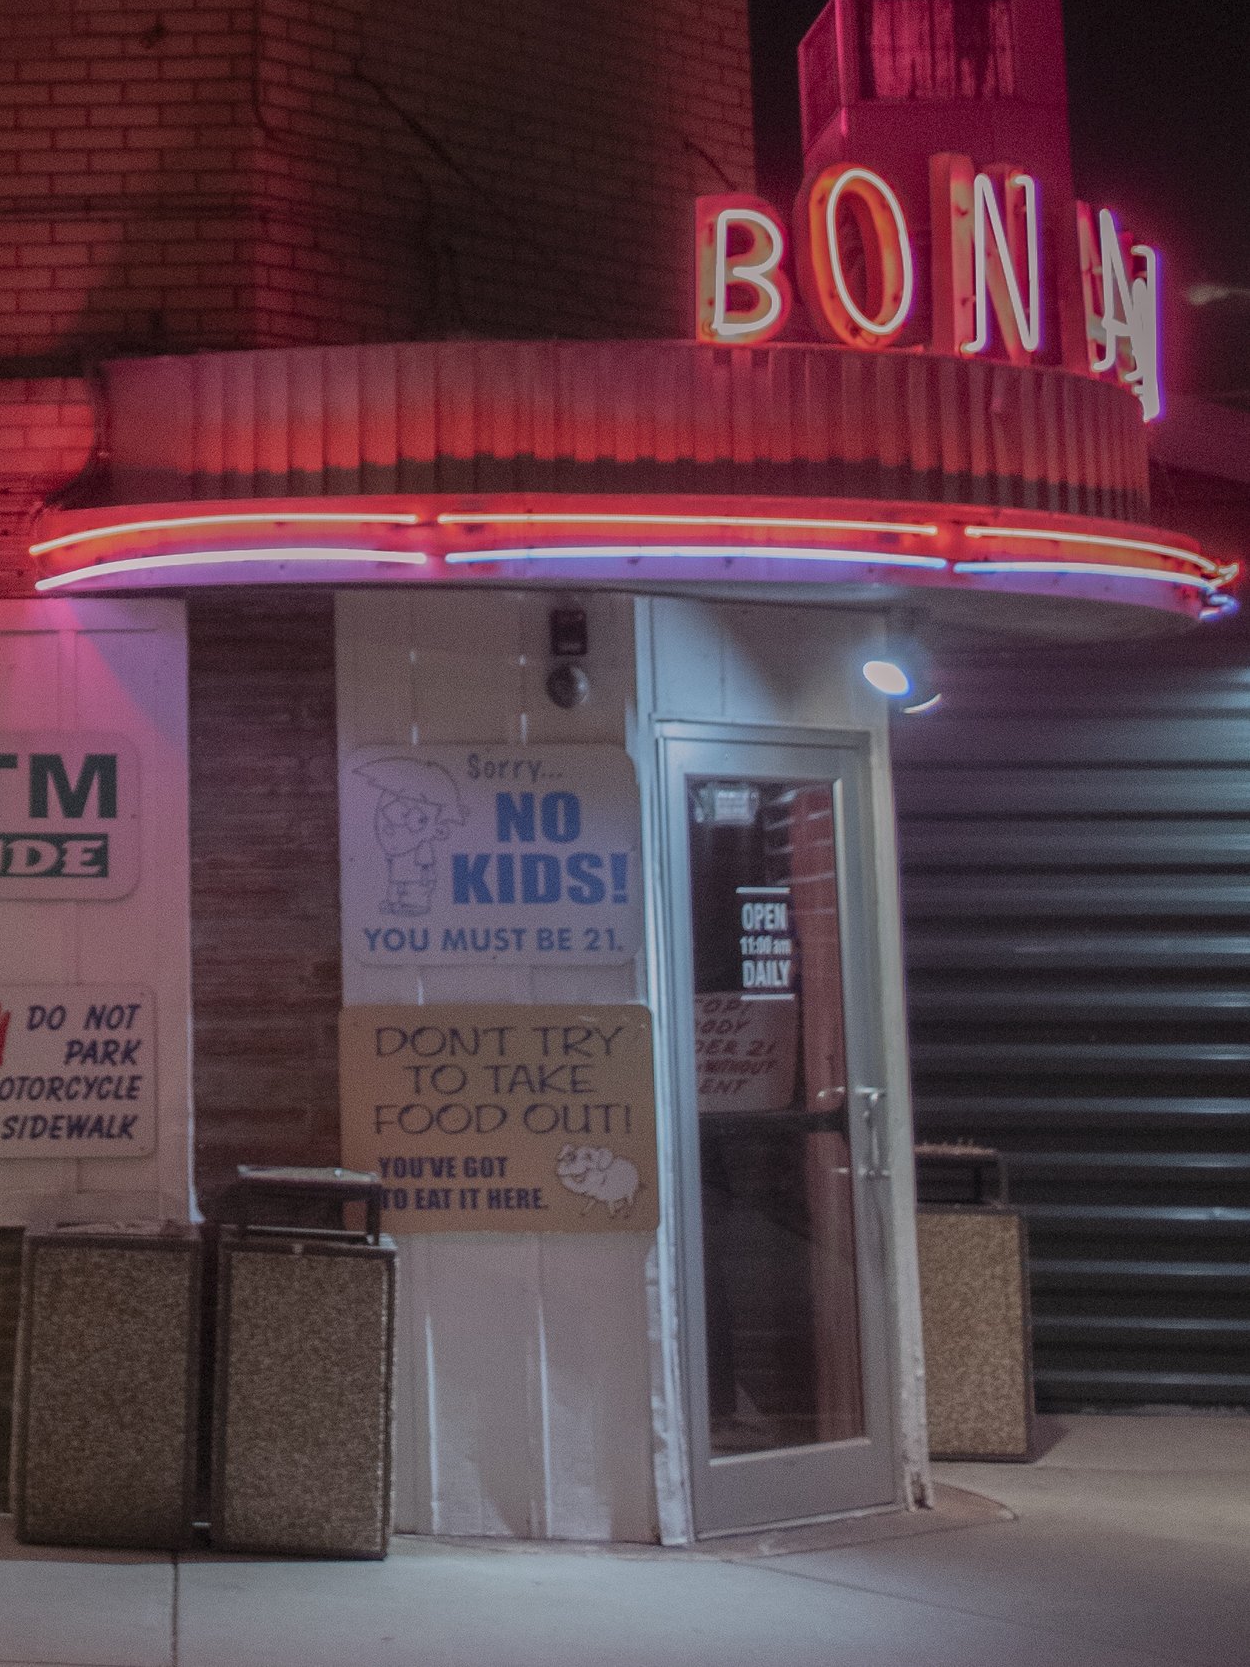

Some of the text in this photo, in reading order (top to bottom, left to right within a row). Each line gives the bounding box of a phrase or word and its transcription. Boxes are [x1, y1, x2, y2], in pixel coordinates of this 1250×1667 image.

[696, 158, 1042, 366] BON
[495, 791, 582, 844] NO
[452, 852, 629, 905] KIDS!
[740, 902, 789, 932] OPEN
[363, 929, 625, 952] YOU MUST BE 21.
[741, 959, 791, 988] DAILY
[26, 1003, 141, 1031] DO NOT
[63, 1039, 142, 1067] PARK
[531, 1025, 625, 1058] TRY
[403, 1064, 598, 1095] TO TAKE
[1, 1114, 139, 1141] SIDEWALK
[373, 1103, 632, 1134] FOOD OUT!
[379, 1156, 508, 1179] YOU'VE GOT
[381, 1188, 408, 1210] TO
[414, 1188, 452, 1210] EAT
[460, 1188, 479, 1210] IT
